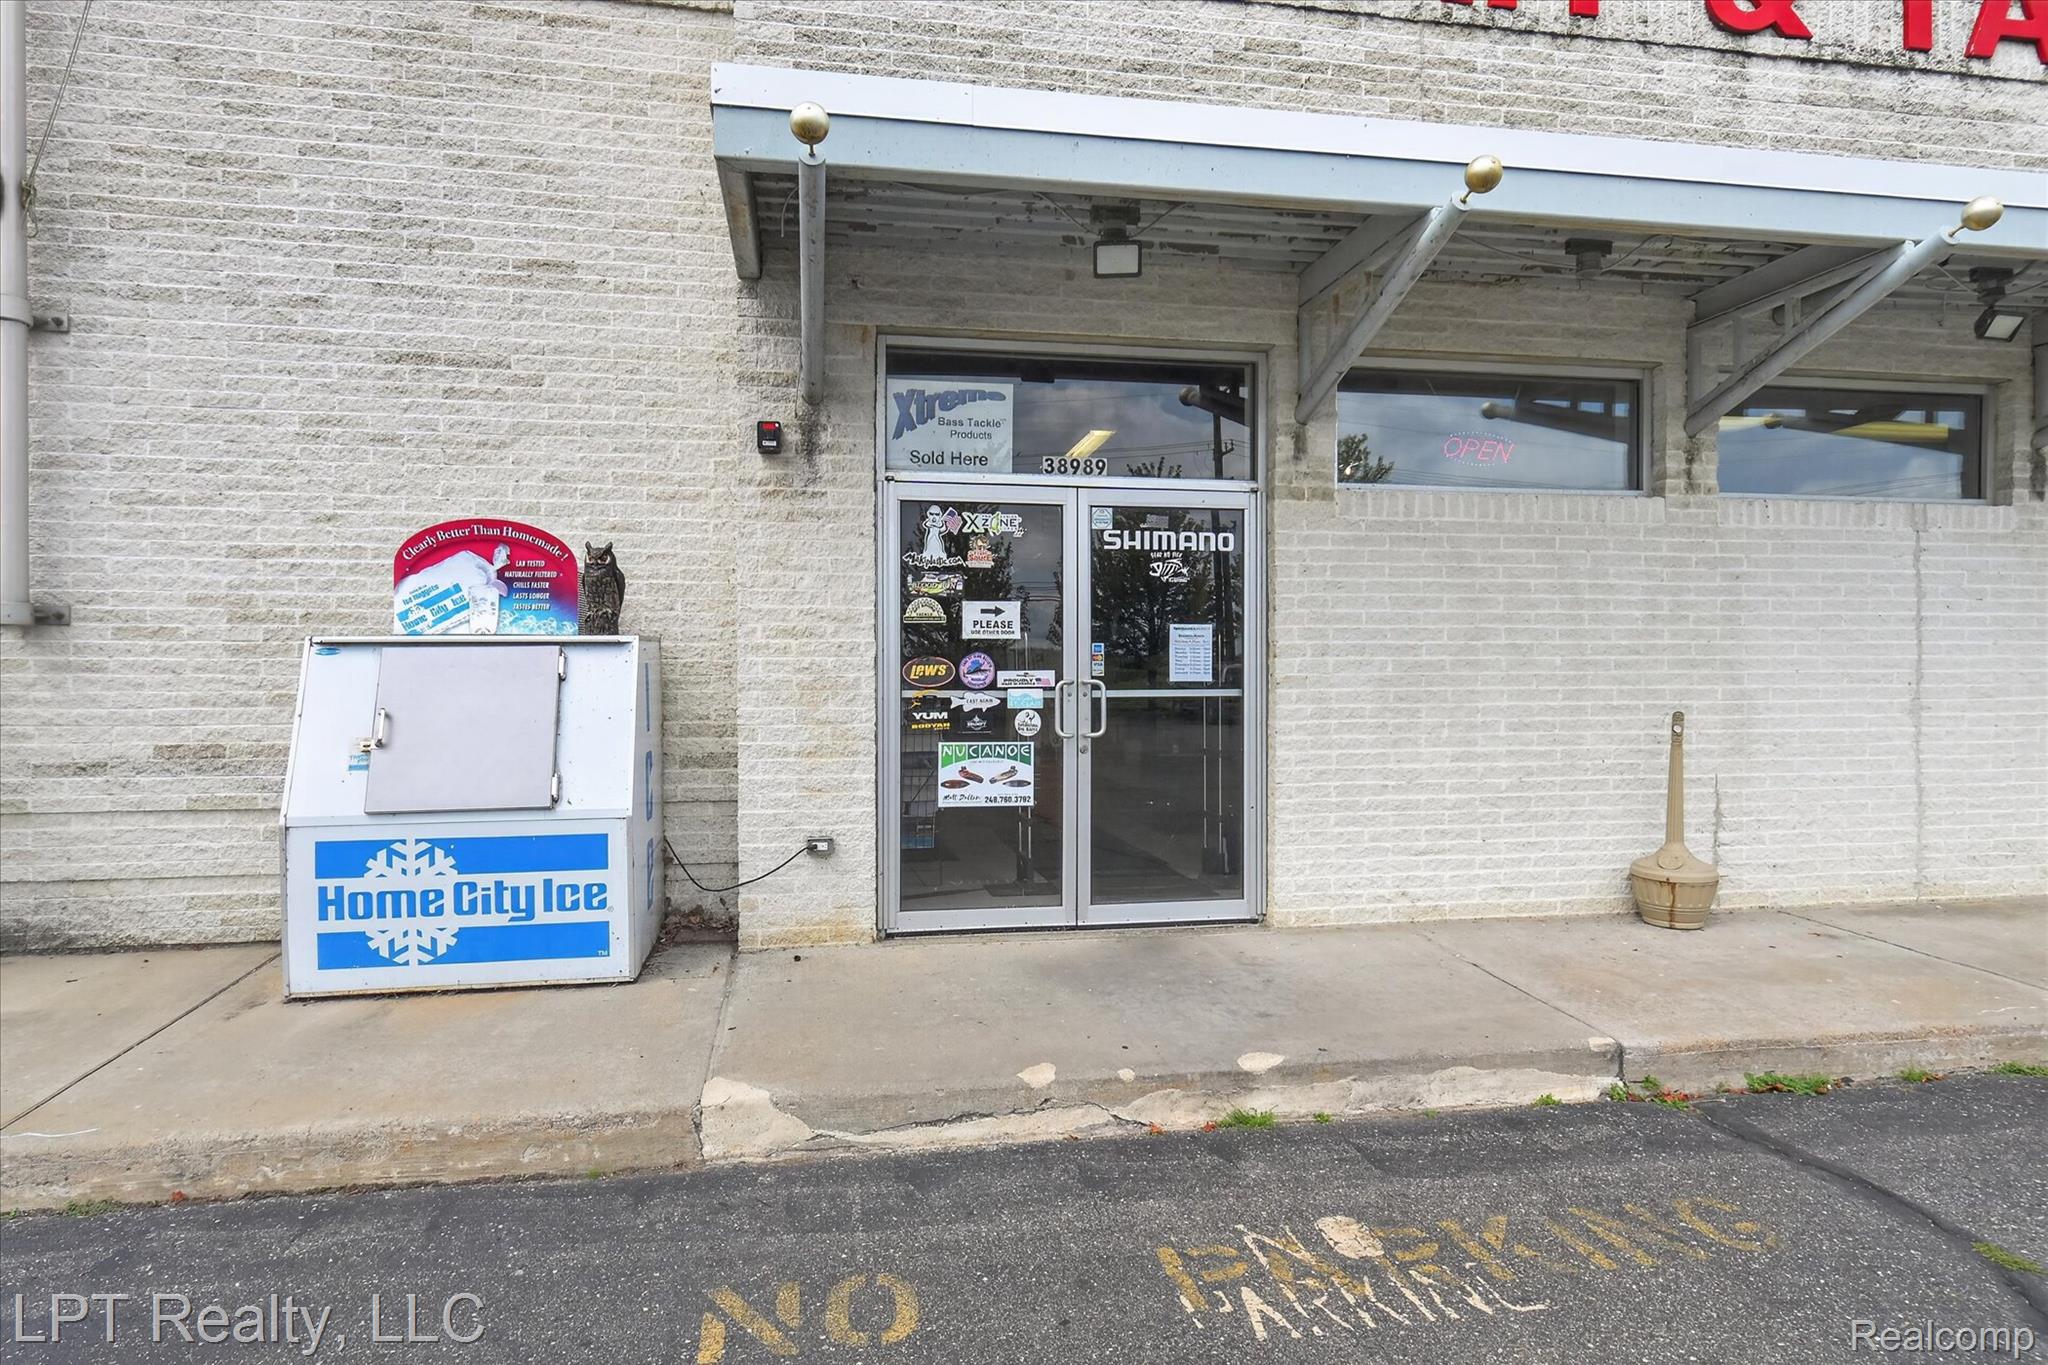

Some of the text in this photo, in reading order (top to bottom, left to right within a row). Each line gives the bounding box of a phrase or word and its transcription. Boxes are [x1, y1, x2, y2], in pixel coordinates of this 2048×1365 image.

[938, 417, 1001, 428] Bass Tackle
[951, 430, 992, 441] Products
[910, 450, 988, 466] Sold Here
[1443, 437, 1515, 464] OPEN
[1043, 458, 1106, 475] 38989
[402, 536, 437, 561] Clearly
[437, 526, 471, 542] Better
[471, 525, 500, 536] Than
[1103, 530, 1234, 551] SHIMANO
[513, 581, 549, 589] CHILLS FASTER
[513, 592, 550, 600] LASTS LONGER
[429, 602, 450, 618] City
[972, 620, 1014, 629] PLEASE
[912, 712, 948, 720] YUM
[942, 745, 1031, 757] NUCANOE
[318, 878, 608, 922] Home City Ice
[696, 1272, 921, 1365] NO
